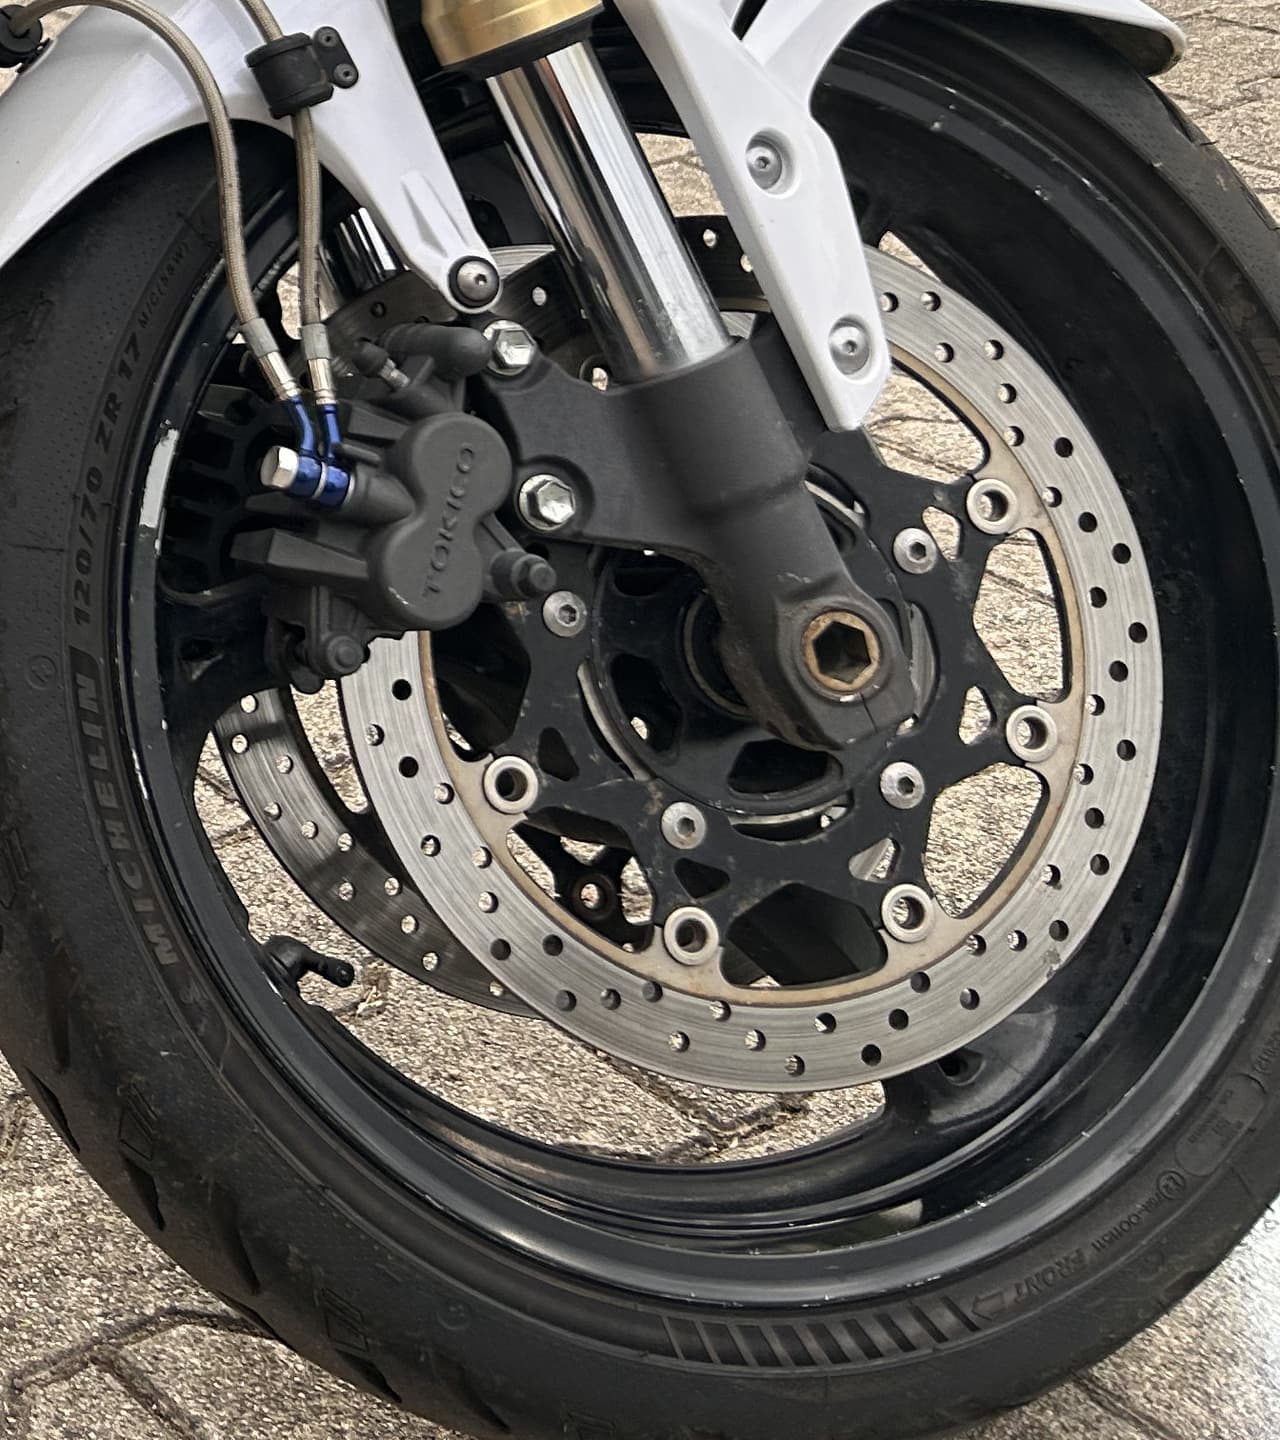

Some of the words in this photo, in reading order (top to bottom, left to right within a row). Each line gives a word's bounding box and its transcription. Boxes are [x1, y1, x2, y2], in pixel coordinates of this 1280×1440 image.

[73, 465, 103, 626] 120/70
[95, 391, 122, 454] ZR
[118, 331, 140, 381] 17
[423, 446, 475, 597] TOKICO
[75, 672, 180, 966] MICHELIN
[1012, 1247, 1087, 1303] FRONT
